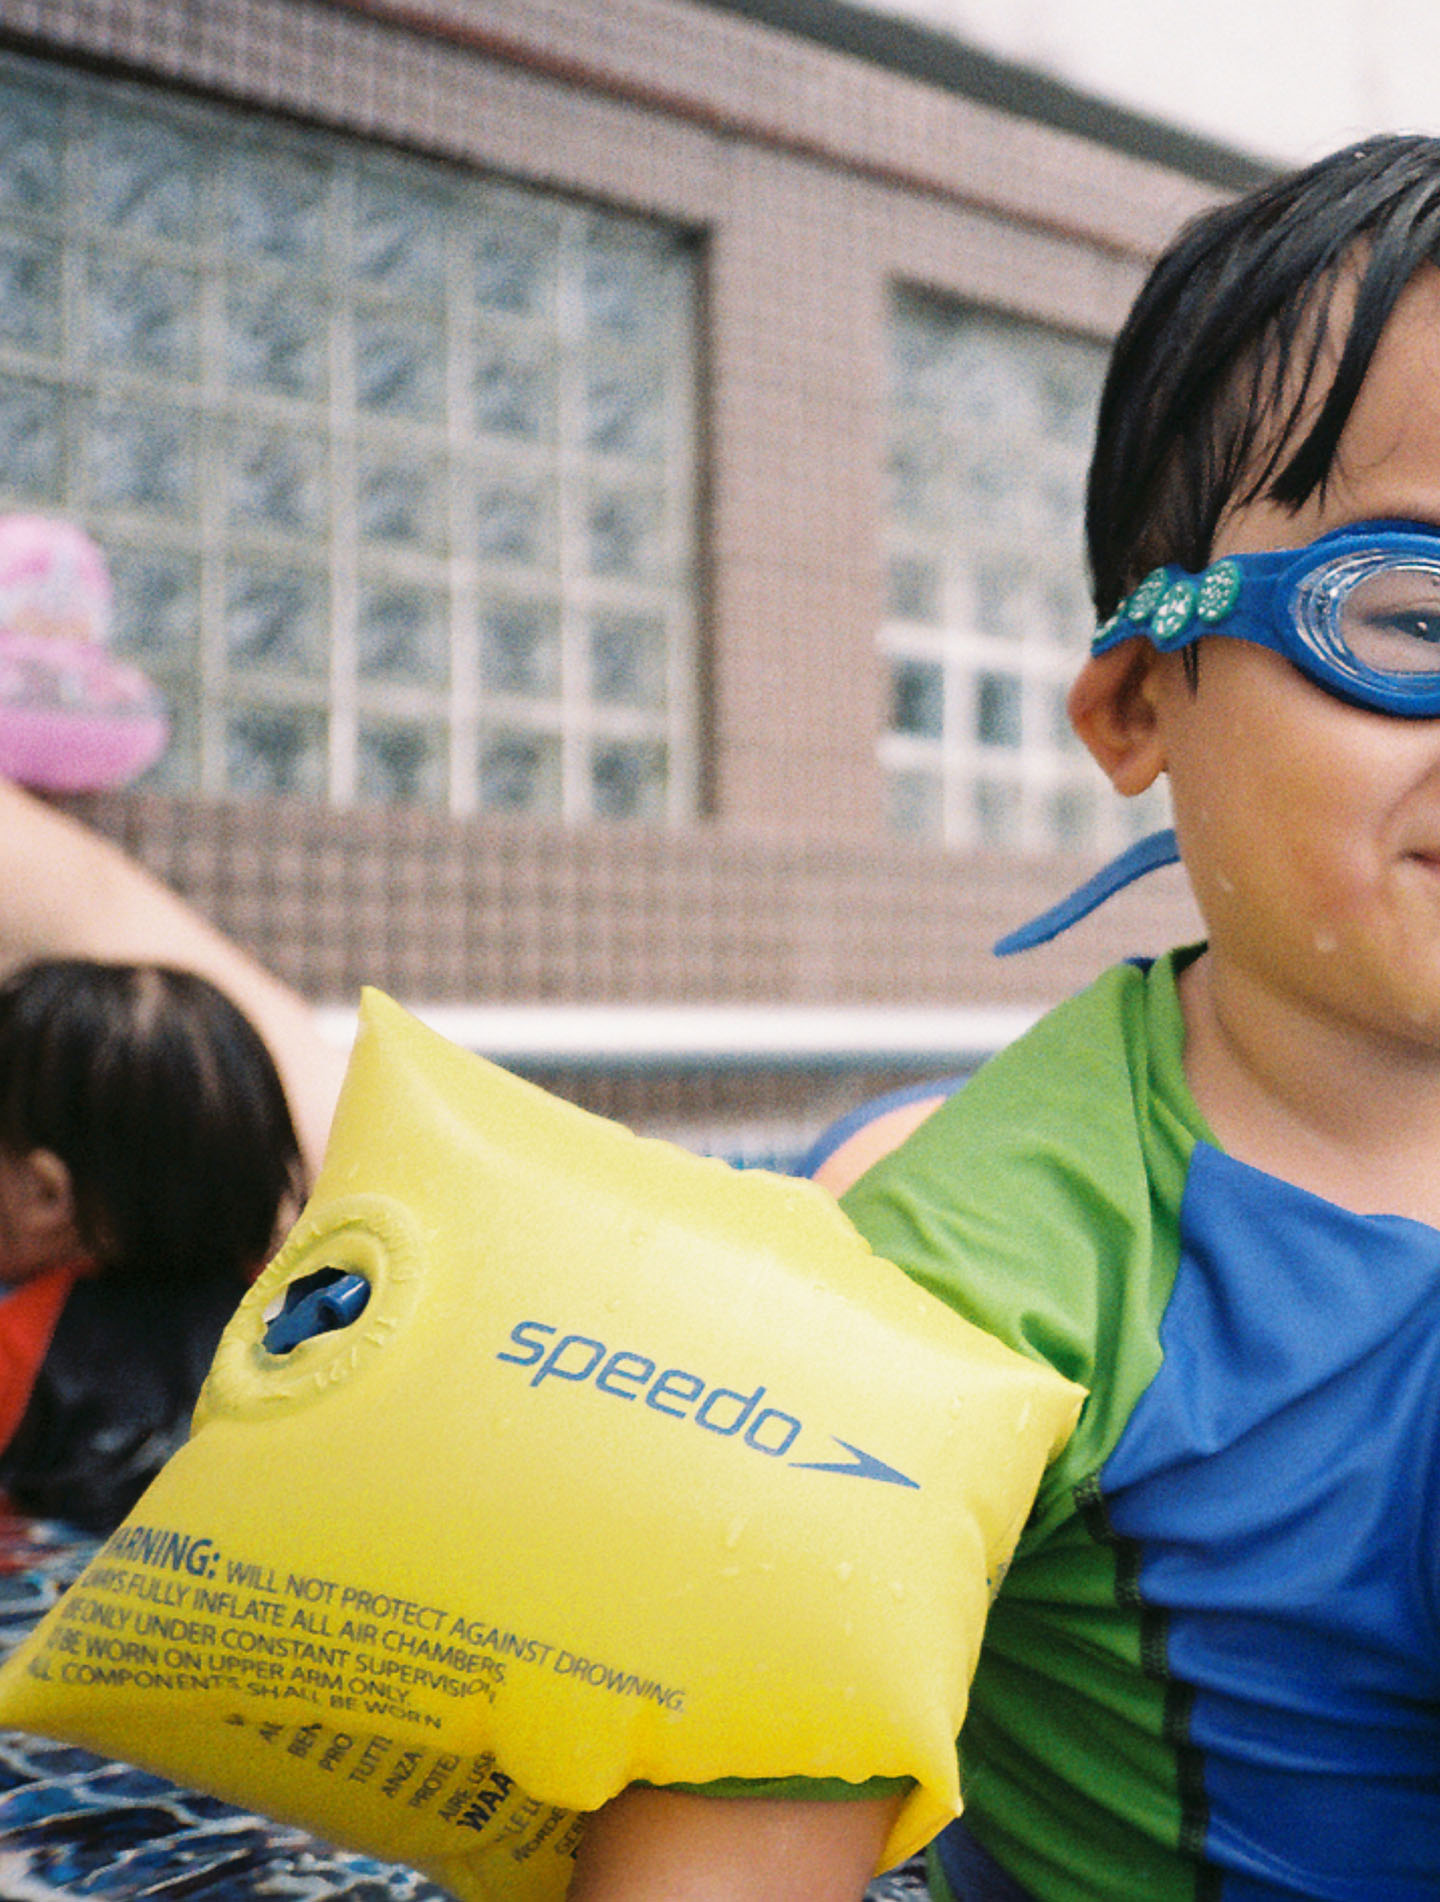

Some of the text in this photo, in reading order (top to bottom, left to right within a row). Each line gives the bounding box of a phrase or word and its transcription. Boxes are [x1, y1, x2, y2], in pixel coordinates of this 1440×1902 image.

[496, 1320, 801, 1457] speedo
[127, 1573, 191, 1606] FULLY
[193, 1588, 286, 1627] INFLATE
[290, 1609, 331, 1636] ALL
[339, 1620, 378, 1645] AIR
[134, 1613, 217, 1645] UNDER
[221, 1628, 351, 1668] CONSTANT
[227, 1560, 278, 1594] WILL
[286, 1574, 338, 1604] NOT
[341, 1586, 448, 1631] PROTECT
[448, 1617, 555, 1665] AGAINST
[61, 1662, 241, 1690] COMPONENTS
[247, 1682, 320, 1704] SHALL
[329, 1694, 355, 1710] BE
[365, 1701, 443, 1729] WORN
[86, 1635, 159, 1667] WORN
[164, 1648, 201, 1671] ON
[208, 1654, 285, 1681] UPPER
[290, 1666, 343, 1692] ARM
